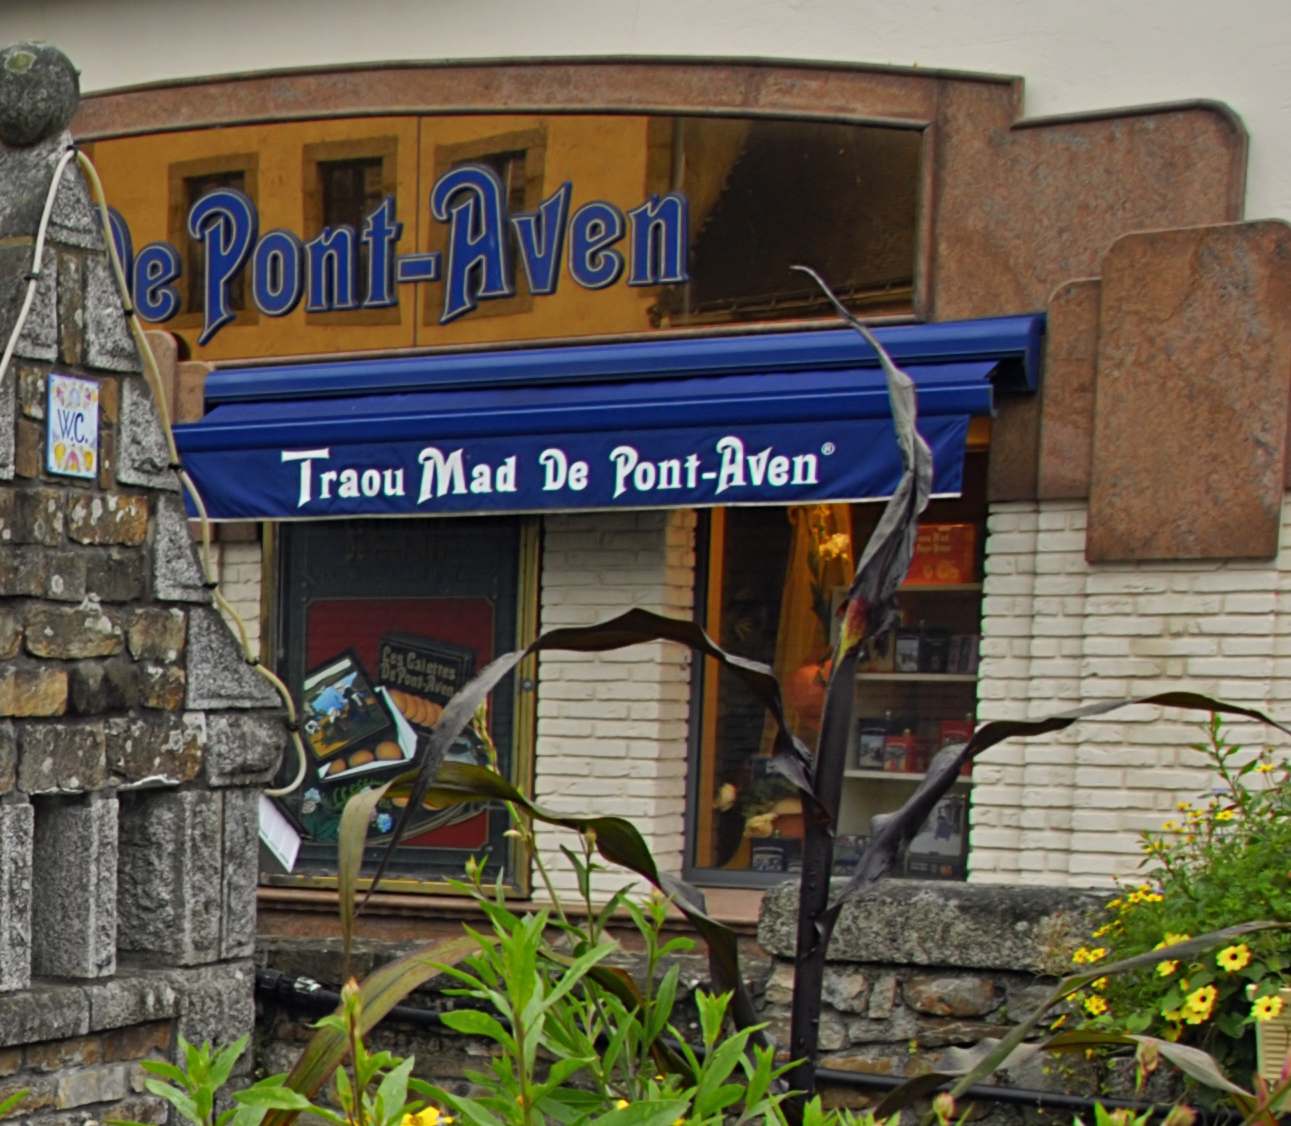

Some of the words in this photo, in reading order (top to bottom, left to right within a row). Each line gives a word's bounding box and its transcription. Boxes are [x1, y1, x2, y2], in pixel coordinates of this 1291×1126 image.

[187, 163, 689, 346] Pont-Aven
[57, 408, 89, 444] W.C.
[281, 448, 405, 508] Traou
[417, 447, 517, 505] Mad
[539, 448, 589, 491] De
